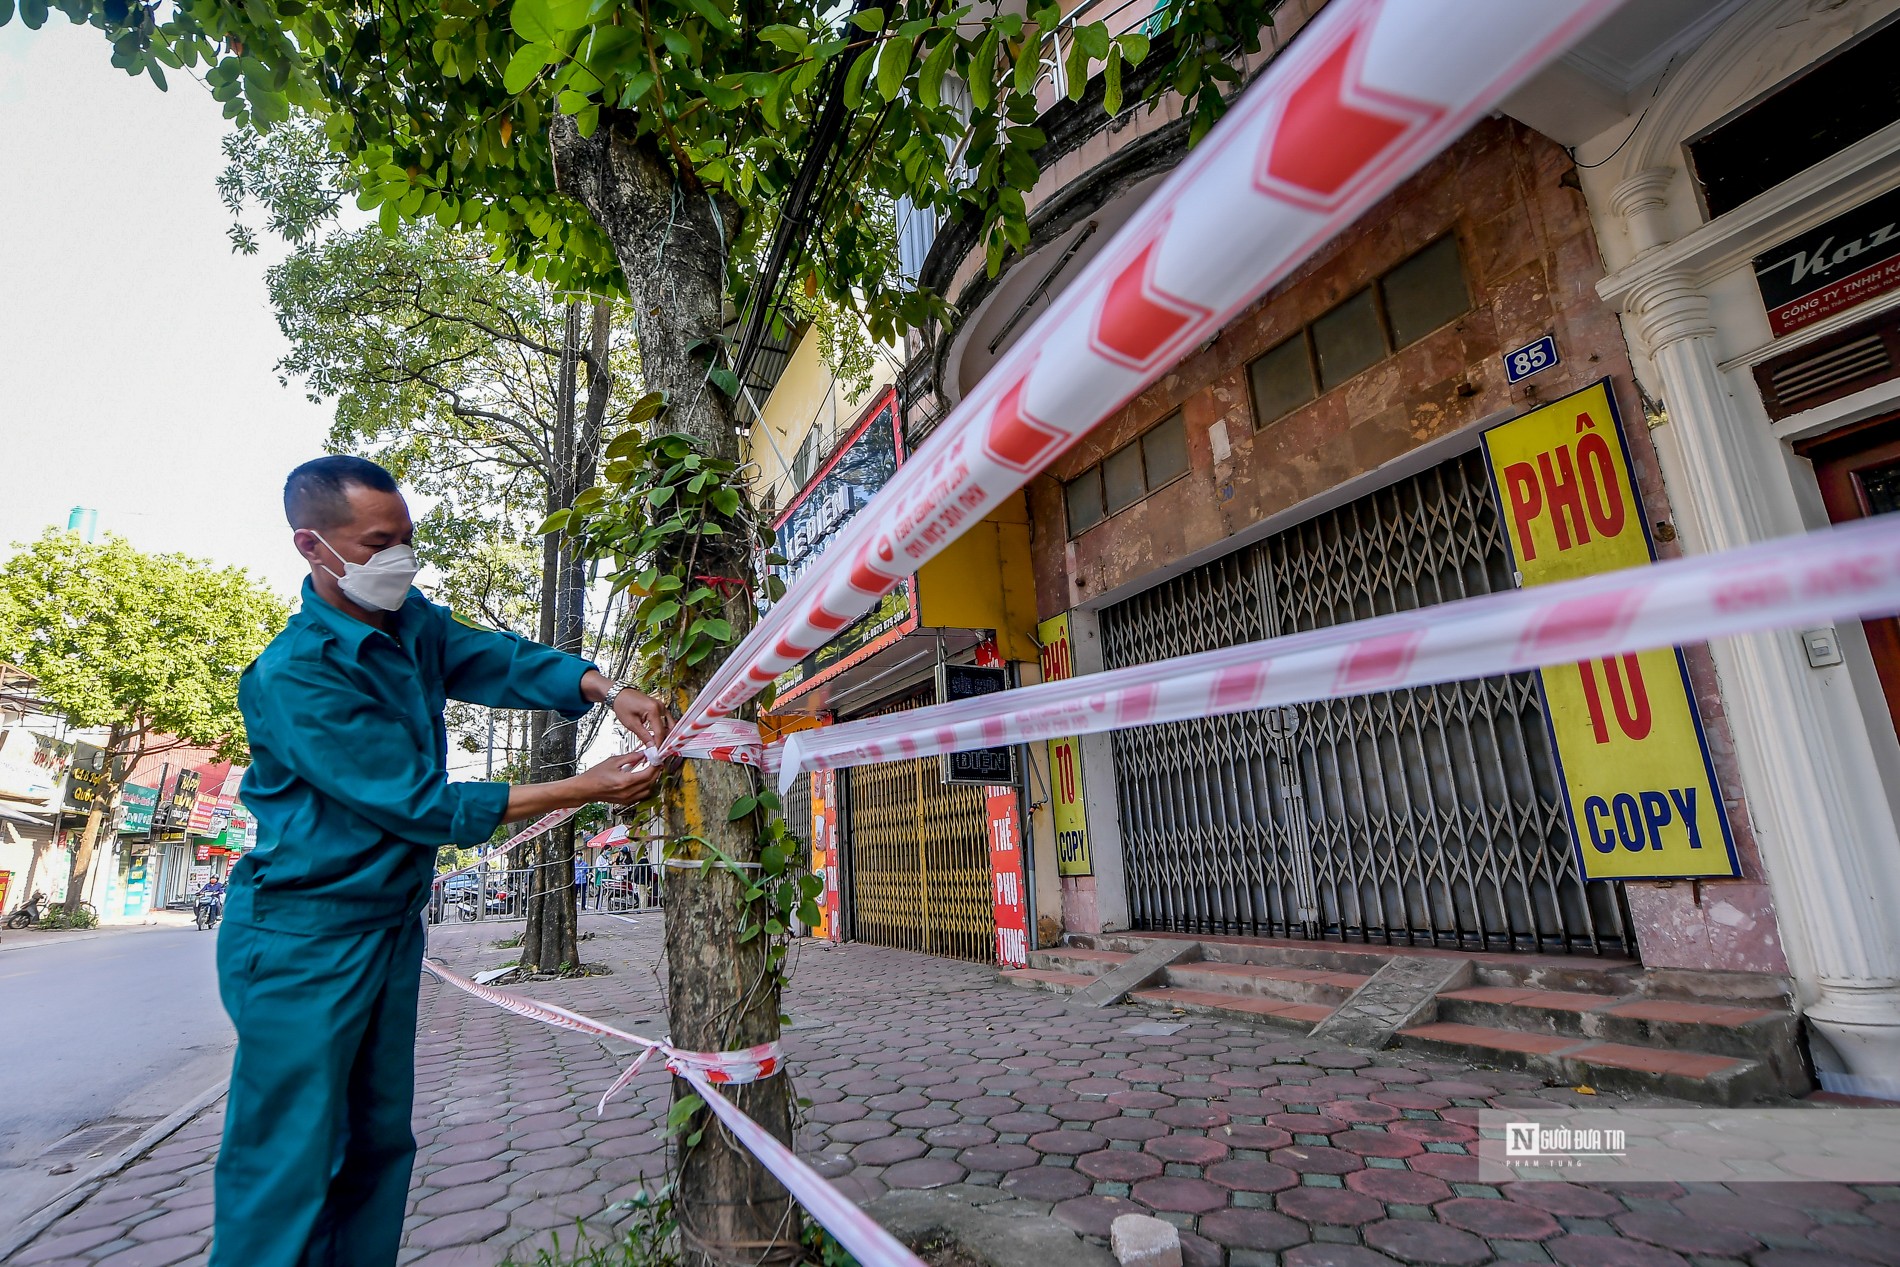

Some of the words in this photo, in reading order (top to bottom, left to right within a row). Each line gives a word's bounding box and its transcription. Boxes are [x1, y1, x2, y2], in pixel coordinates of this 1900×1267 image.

[1781, 298, 1819, 320] CÔNG
[1822, 288, 1841, 302] TY
[1843, 270, 1882, 293] TNHH
[1514, 343, 1547, 375] 85
[1504, 412, 1626, 562] PHÔ
[1043, 626, 1071, 681] PHÔ
[956, 748, 1006, 774] ĐIỆN
[993, 806, 1013, 852] THẾ
[1584, 787, 1703, 854] COPY
[1059, 829, 1085, 862] COPY
[996, 872, 1018, 912] PHỤ
